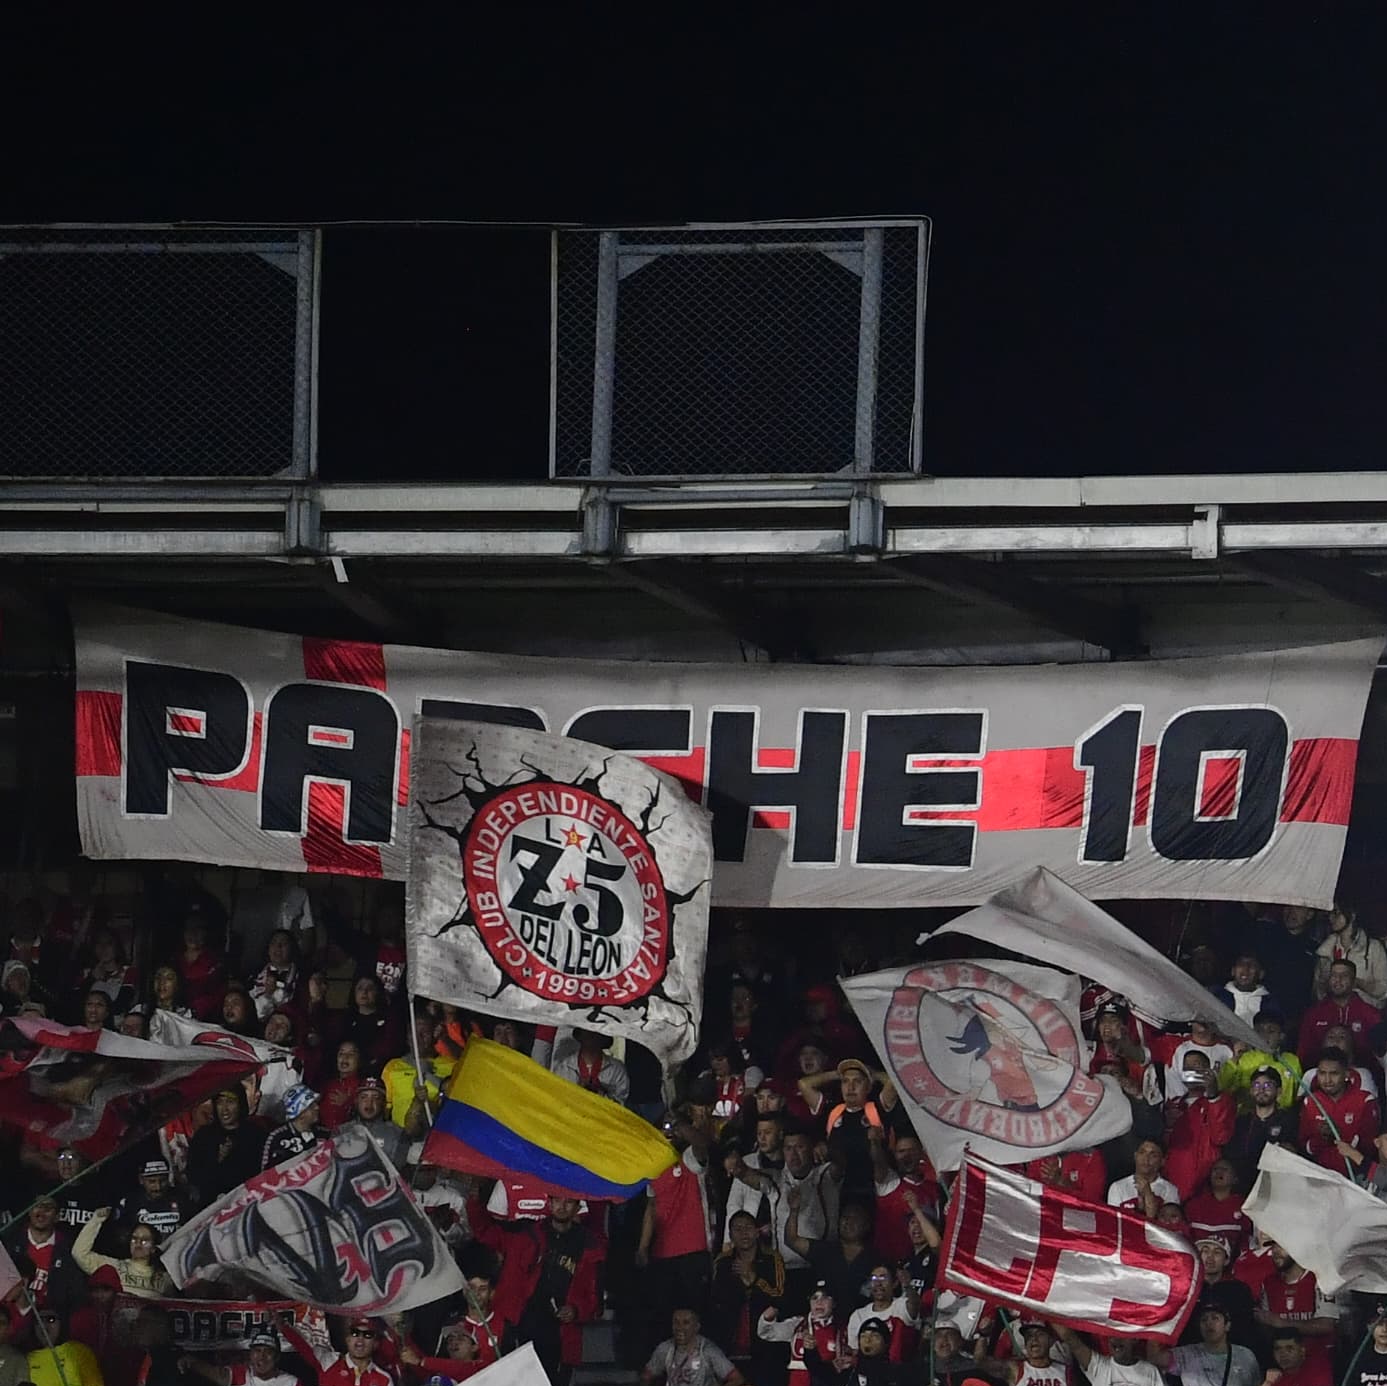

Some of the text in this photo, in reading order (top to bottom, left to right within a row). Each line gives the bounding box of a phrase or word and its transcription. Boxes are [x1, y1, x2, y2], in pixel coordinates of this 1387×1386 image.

[121, 655, 1292, 870] PAHE 10
[477, 891, 527, 967] CLUB
[519, 913, 622, 977] DEL LEON
[535, 971, 595, 1000] 1999
[280, 1137, 304, 1153] 23
[60, 1208, 96, 1225] EATLES
